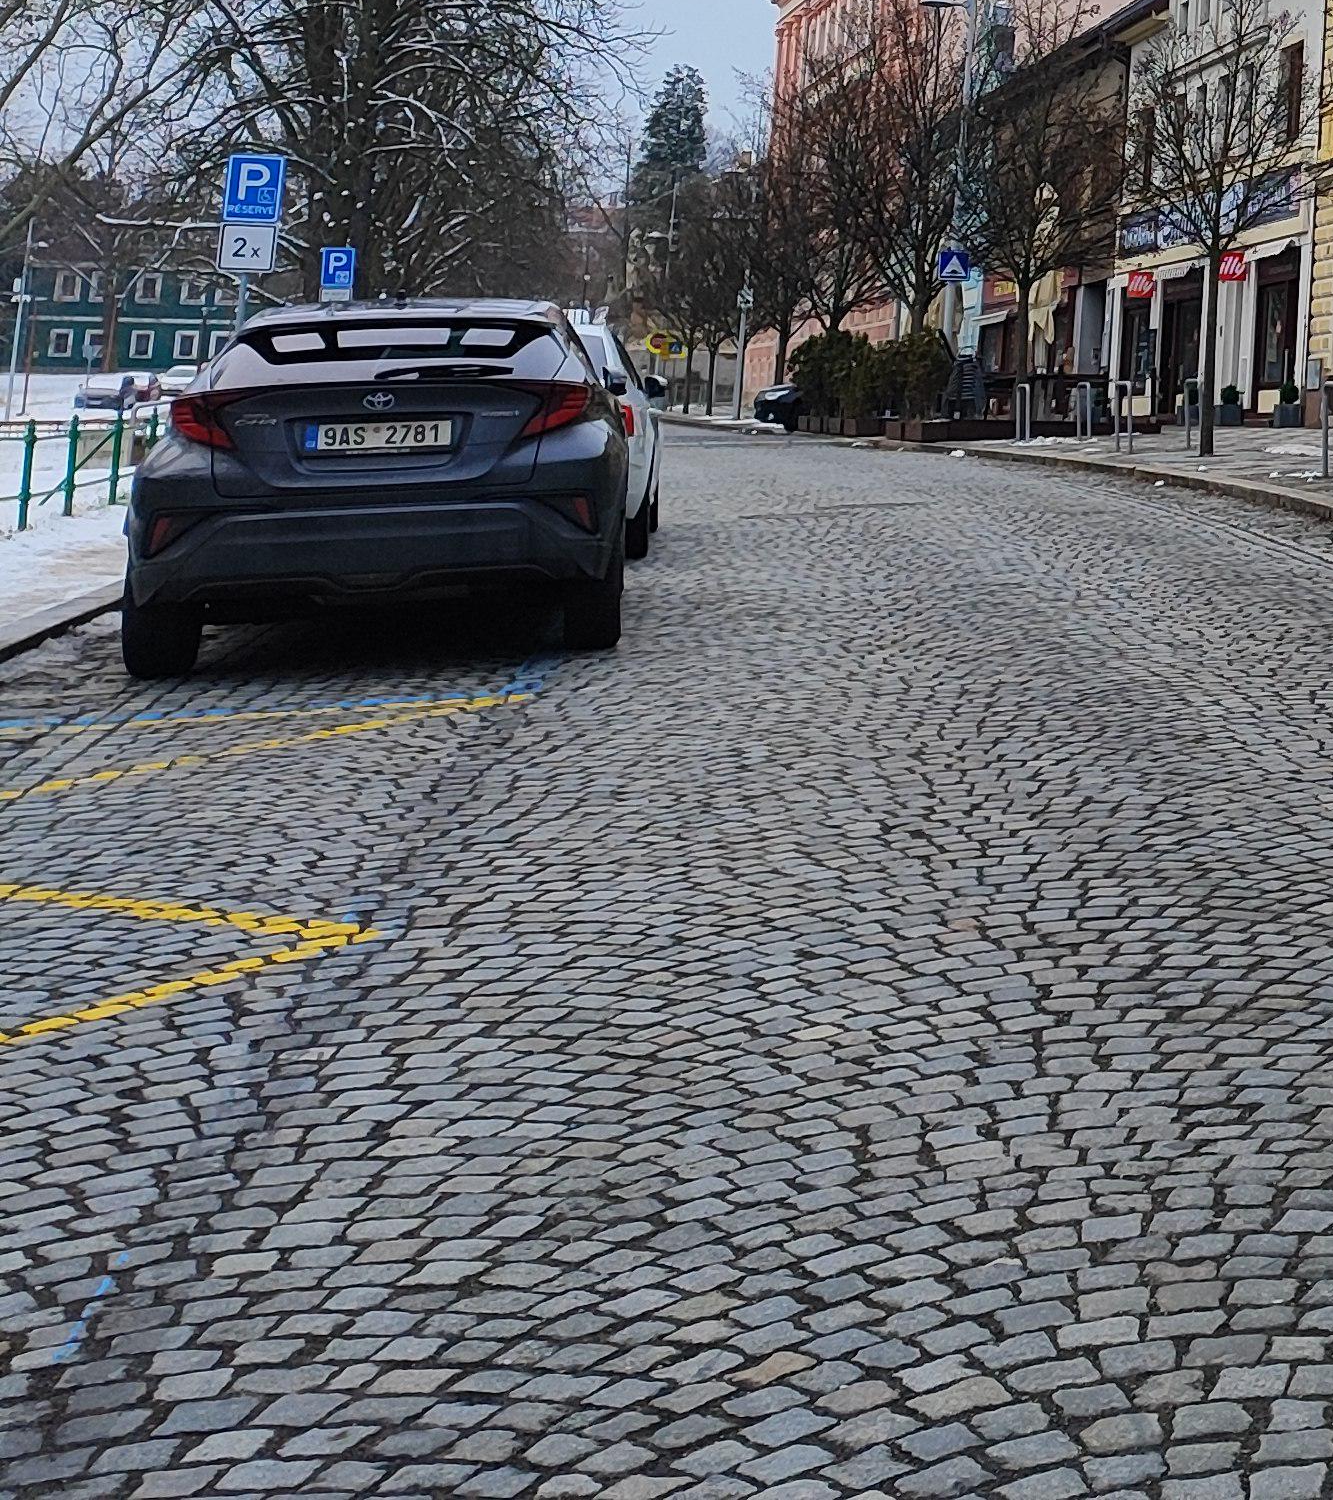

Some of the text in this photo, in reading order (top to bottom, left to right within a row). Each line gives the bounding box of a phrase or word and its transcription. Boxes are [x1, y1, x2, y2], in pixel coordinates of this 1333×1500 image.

[237, 162, 271, 201] P
[328, 252, 348, 275] P
[1219, 256, 1246, 279] illy
[1128, 275, 1154, 296] illy
[323, 423, 440, 447] 9AS 2781
